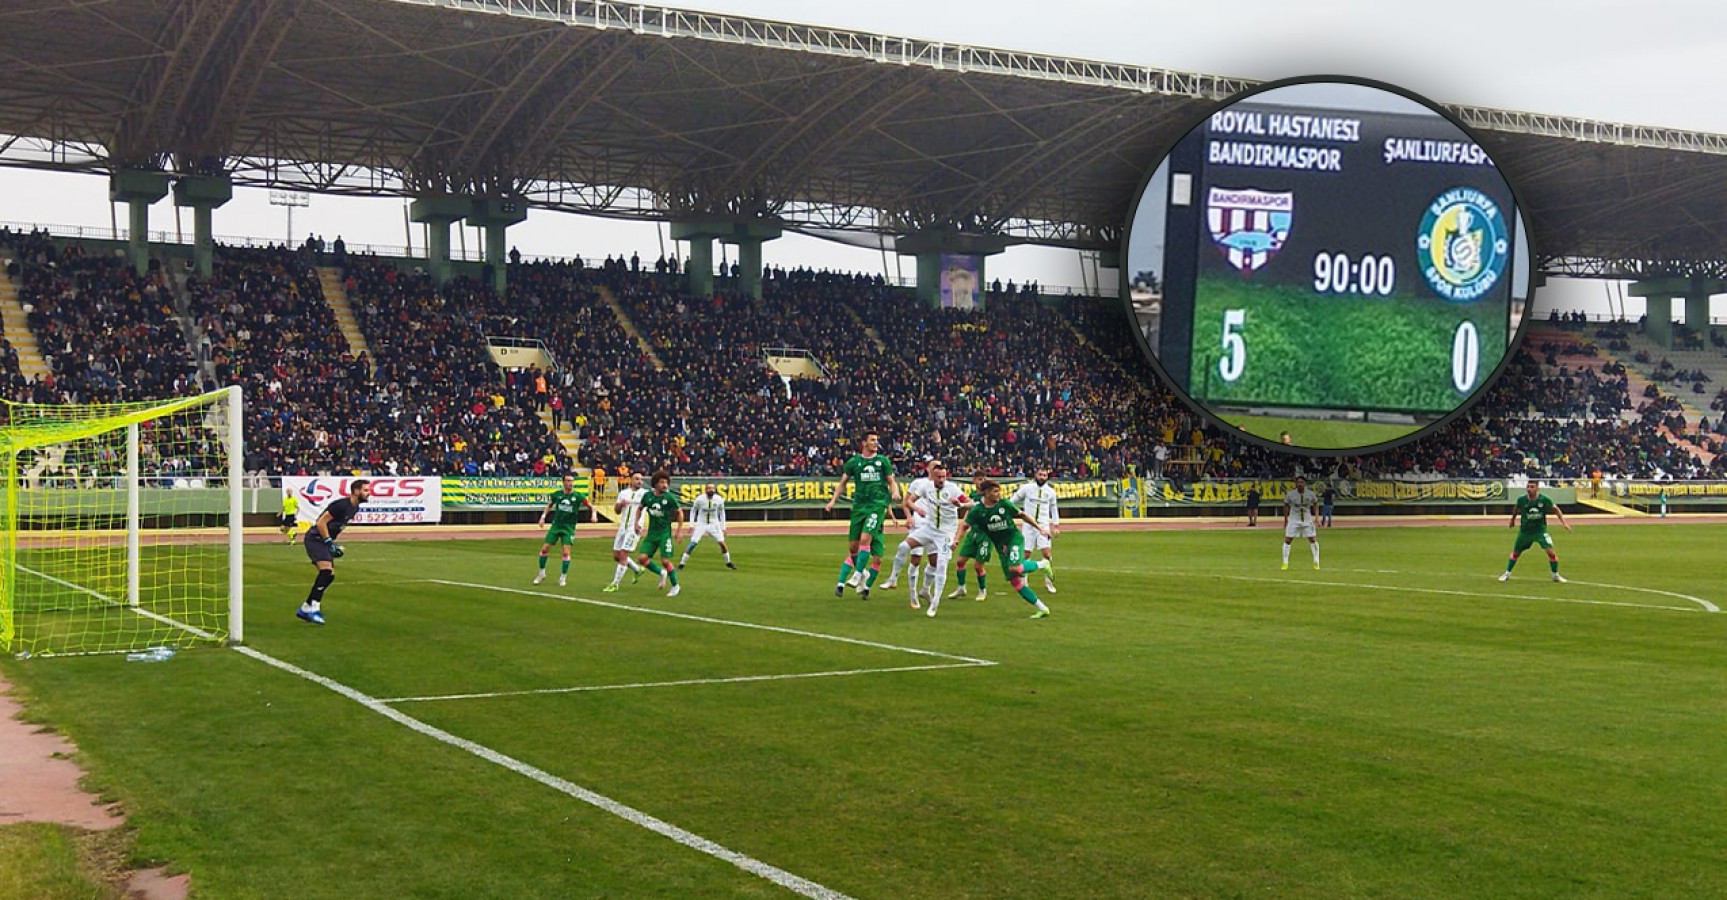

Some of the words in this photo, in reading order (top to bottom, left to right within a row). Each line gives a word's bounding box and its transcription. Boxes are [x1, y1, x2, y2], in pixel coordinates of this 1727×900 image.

[1211, 110, 1266, 135] ROYAL
[1269, 114, 1360, 142] HASTANESI
[1208, 141, 1342, 171] BANDIRMASPOR
[1384, 137, 1495, 166] ŞANLIURFASP
[1314, 253, 1395, 295] 90:00
[1219, 308, 1246, 382] 5
[1452, 321, 1479, 392] 0
[717, 483, 782, 502] SAHADA
[366, 513, 388, 523] 522
[391, 513, 405, 522] 24
